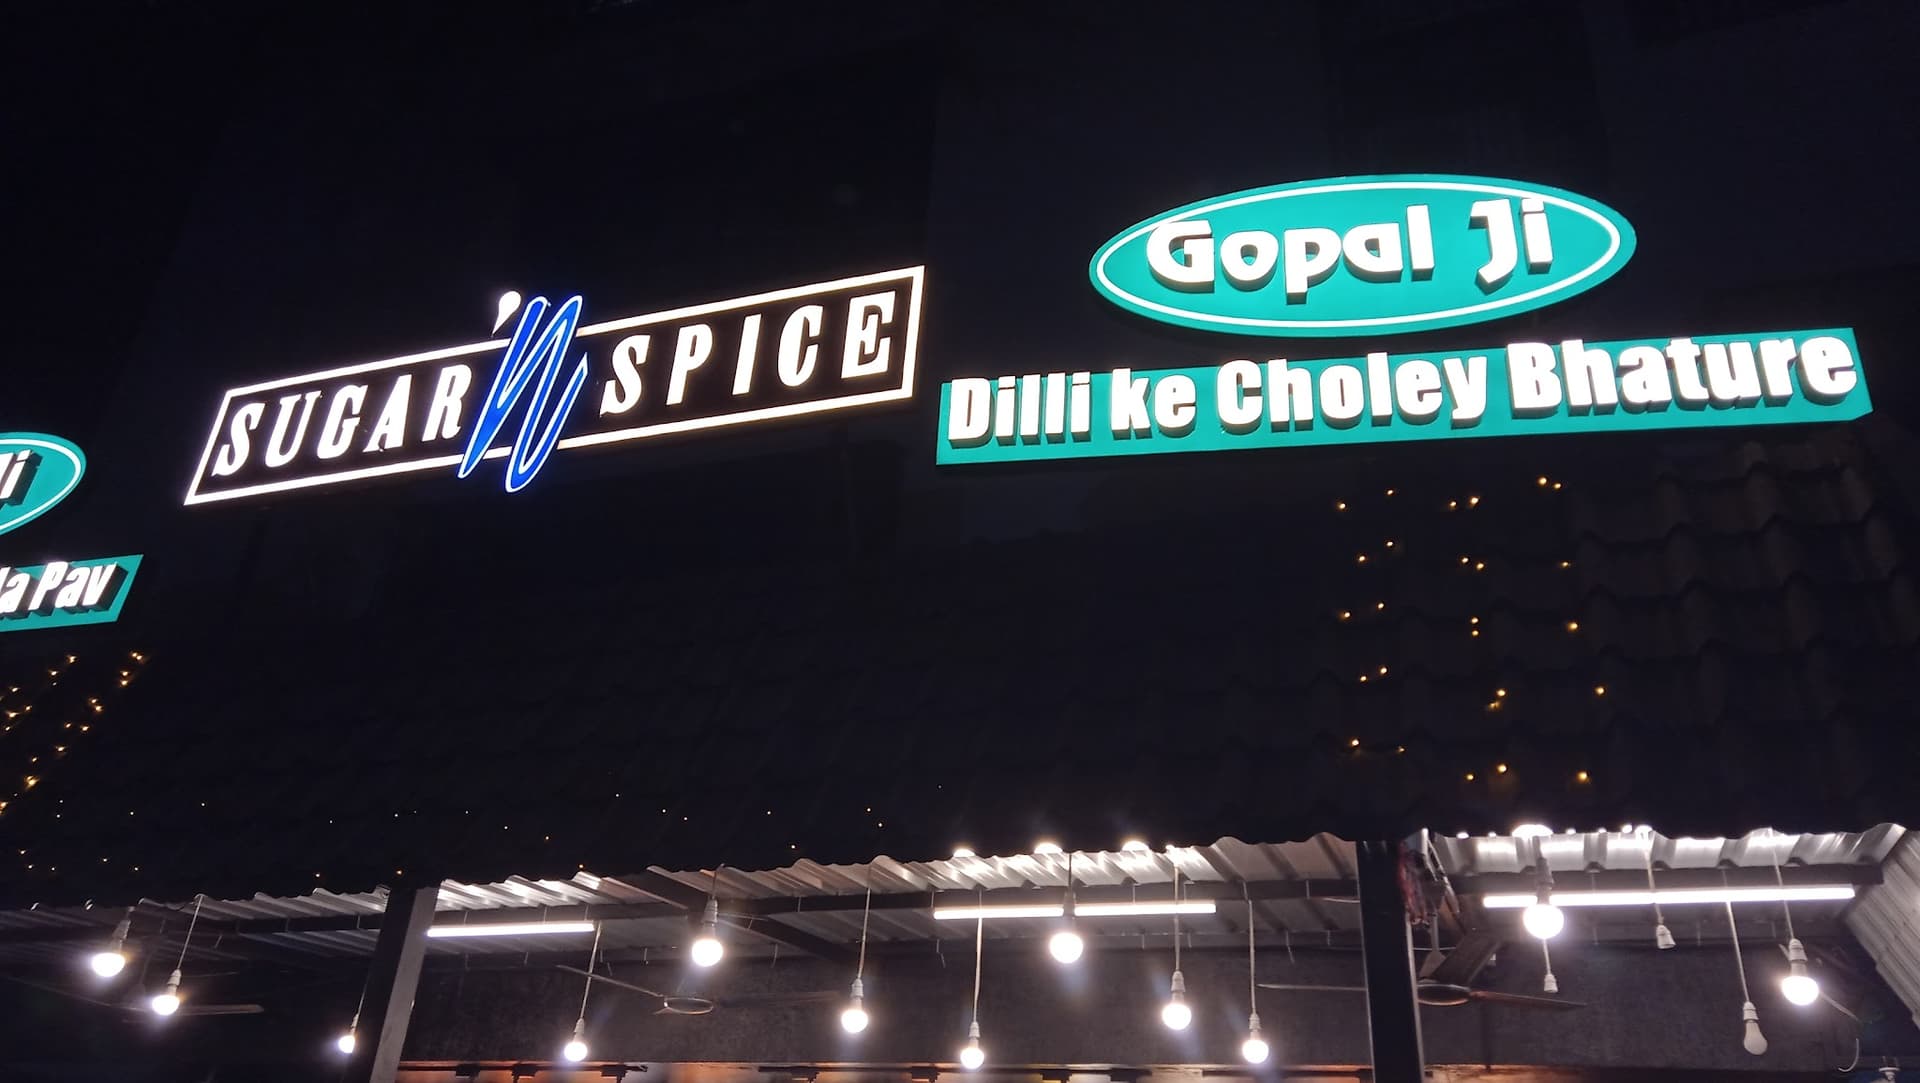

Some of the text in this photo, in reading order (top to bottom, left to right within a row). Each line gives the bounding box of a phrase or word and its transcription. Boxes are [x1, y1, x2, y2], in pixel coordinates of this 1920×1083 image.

[1146, 197, 1554, 304] Gopal Ji
[210, 364, 476, 478] SUGAR
[600, 290, 896, 417] SPICE
[948, 334, 1858, 446] Dilli ke Choley Bhature
[0, 561, 119, 614] a Pav
